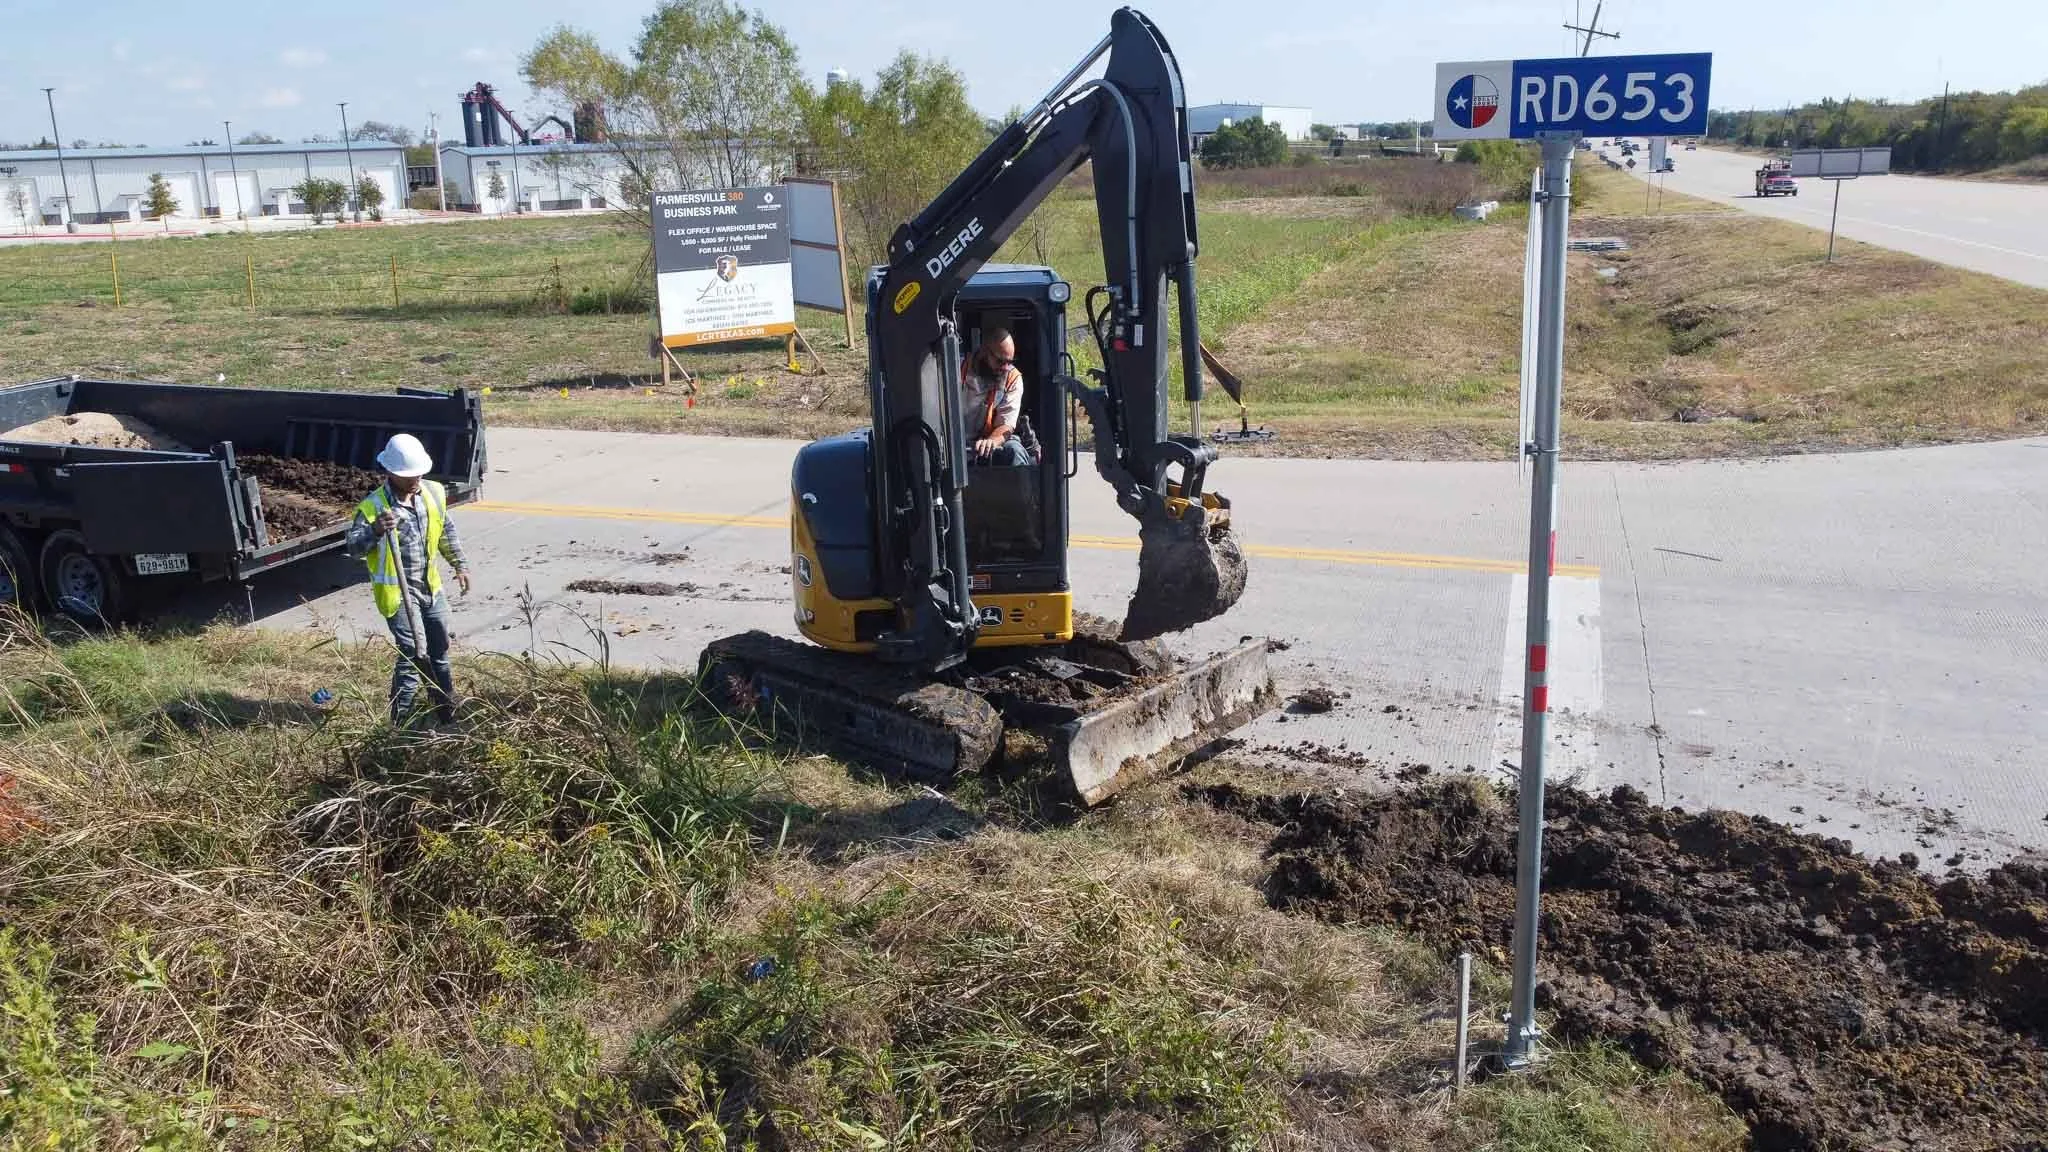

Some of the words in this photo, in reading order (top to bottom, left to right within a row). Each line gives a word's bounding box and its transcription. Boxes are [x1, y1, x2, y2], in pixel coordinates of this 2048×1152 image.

[1519, 71, 1695, 124] RD653
[656, 192, 726, 205] FARMERSVILLE
[727, 191, 744, 201] 380
[664, 206, 711, 218] BUSINESS
[713, 205, 738, 216] PARK
[668, 228, 686, 236] FLEX
[686, 226, 711, 235] OFFICE
[715, 223, 757, 233] WAREHOUSE
[757, 222, 777, 231] SPACE
[926, 217, 984, 279] DEERE
[696, 327, 765, 342] LCRTEXAS.com
